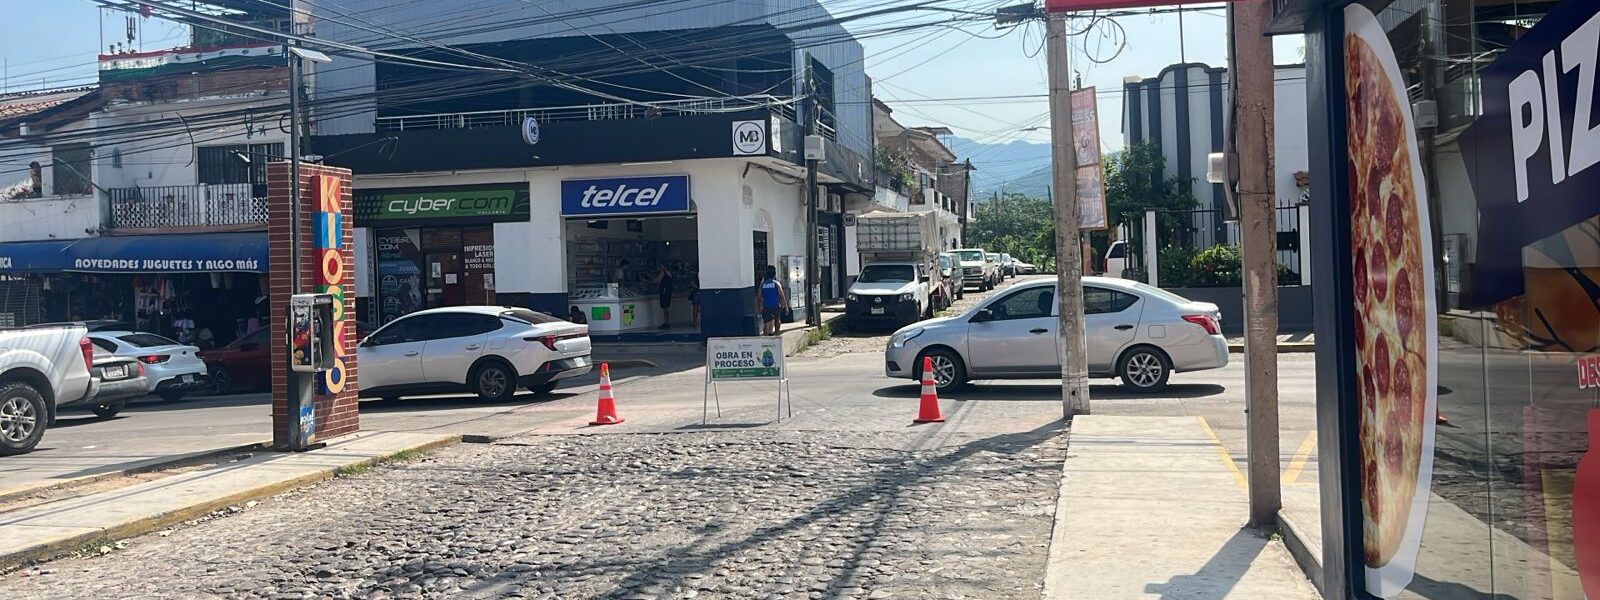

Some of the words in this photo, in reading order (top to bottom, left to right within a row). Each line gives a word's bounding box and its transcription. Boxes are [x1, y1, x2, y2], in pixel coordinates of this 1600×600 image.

[740, 130, 759, 143] MB
[581, 182, 670, 208] telcel
[388, 196, 508, 215] cyber.com
[75, 259, 139, 269] NOVEDADES
[143, 259, 193, 270] JUGUETES
[196, 260, 203, 269] Y
[206, 259, 234, 269] ALGO
[236, 257, 258, 269] MÁS
[741, 351, 753, 359] EN
[714, 360, 755, 368] PROCESO
